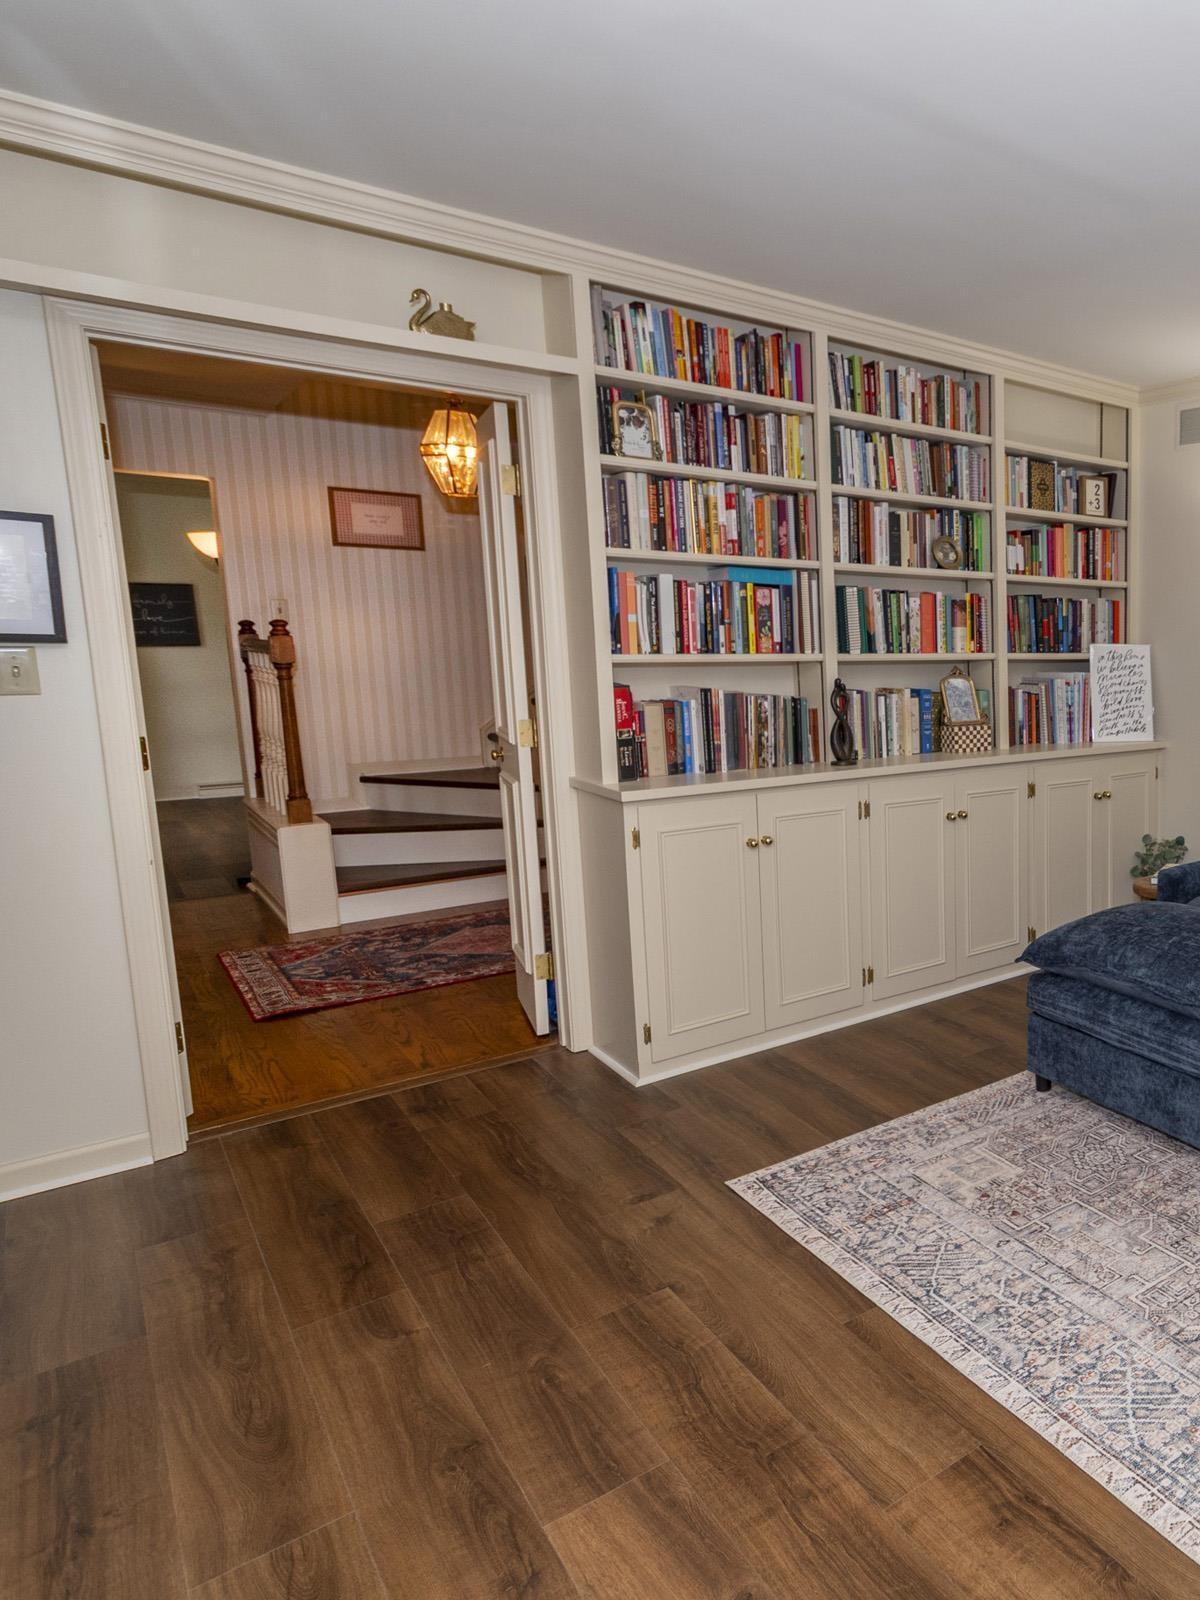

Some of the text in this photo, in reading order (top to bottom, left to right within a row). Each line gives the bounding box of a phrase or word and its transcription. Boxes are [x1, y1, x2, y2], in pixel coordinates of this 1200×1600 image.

[1094, 483, 1100, 496] 2
[1106, 650, 1123, 661] this
[1109, 661, 1136, 673] believe
